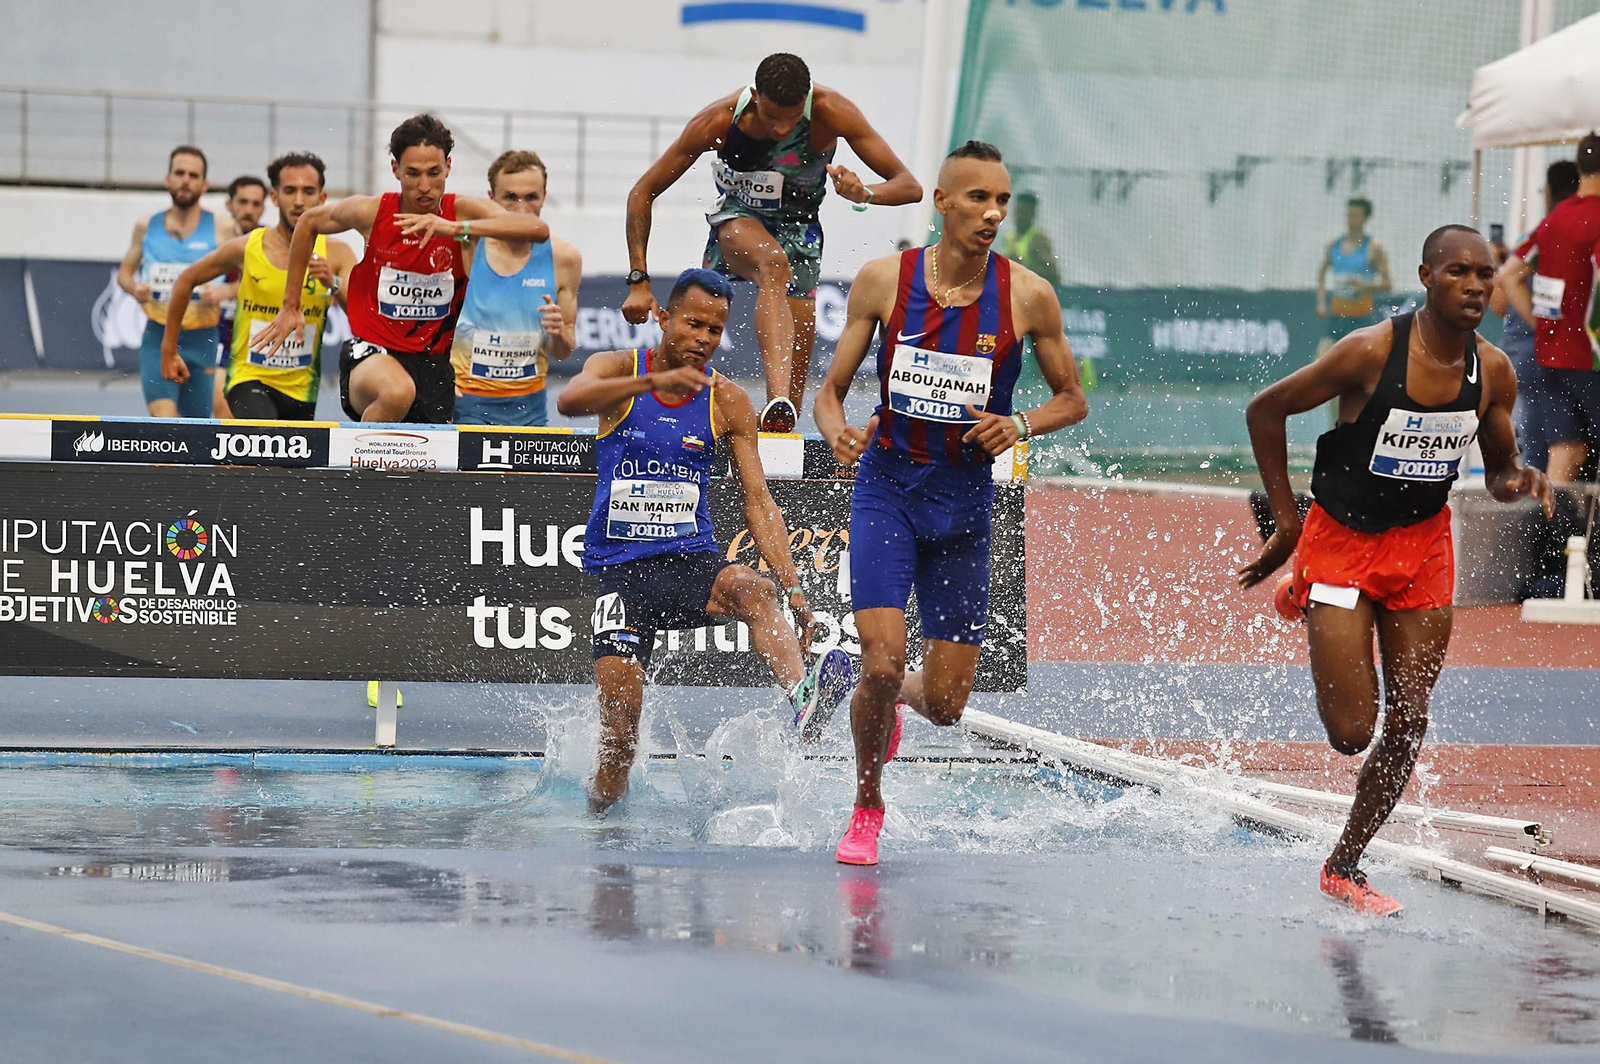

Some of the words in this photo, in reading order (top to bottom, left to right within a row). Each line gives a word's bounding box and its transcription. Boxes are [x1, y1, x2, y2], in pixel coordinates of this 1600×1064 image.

[388, 285, 443, 299] OUGRA
[242, 299, 280, 315] Fiamm
[890, 369, 986, 395] ABOUJANAH
[930, 389, 947, 401] 68
[107, 439, 189, 454] IBERDROLA
[514, 440, 589, 453] DIPUTACIÓN
[1382, 432, 1469, 450] KIPSANG
[514, 453, 530, 465] DE
[533, 454, 581, 466] HUELVA
[1420, 449, 1436, 460] 65
[612, 459, 701, 484] COLOMBIA
[611, 500, 639, 512] SAN
[644, 502, 694, 513] MARTIN
[648, 512, 662, 522] 71
[2, 509, 238, 560] IPUTACIÓN
[470, 507, 588, 568] Hue
[3, 559, 26, 593] E
[51, 560, 236, 597] HUELVA
[0, 596, 138, 625] BJETIVOS
[139, 597, 156, 609] DE
[157, 598, 237, 611] DESARROLLO
[138, 609, 237, 626] SOSTENIBLE
[596, 596, 623, 629] 14
[467, 595, 573, 650] tus
